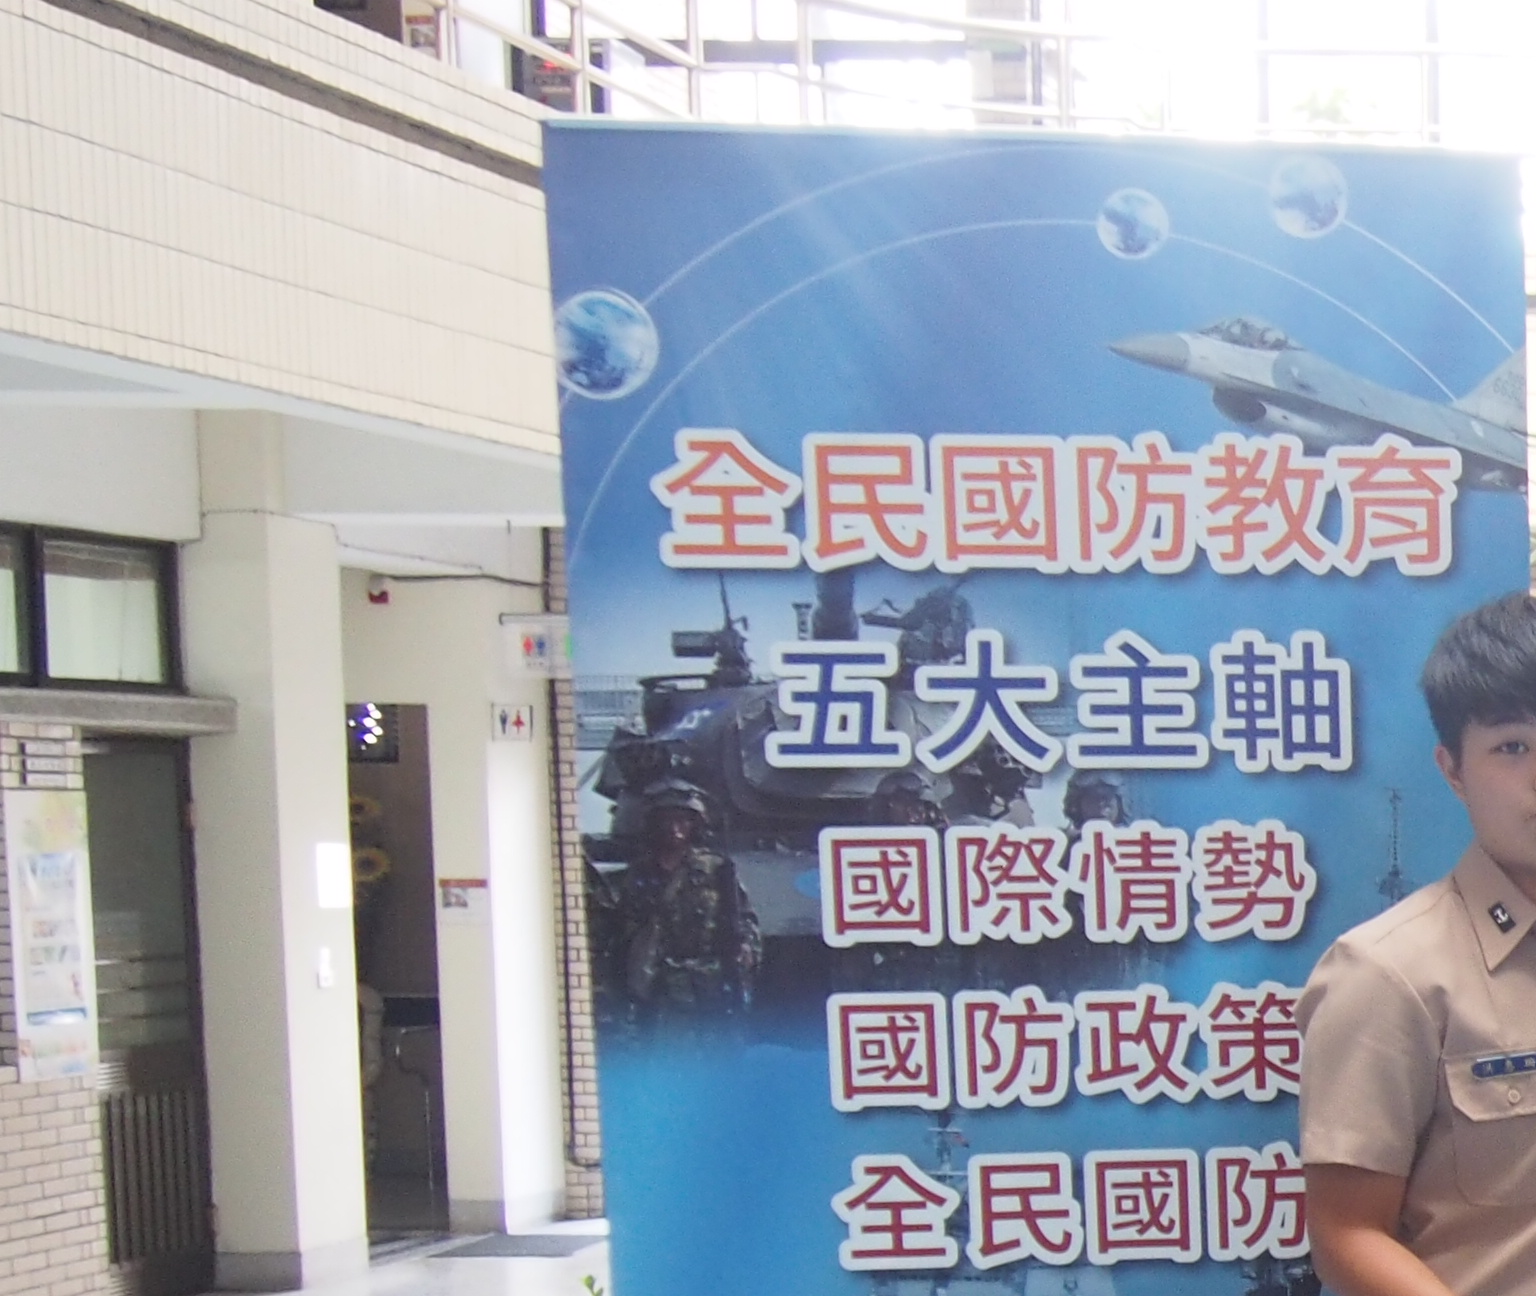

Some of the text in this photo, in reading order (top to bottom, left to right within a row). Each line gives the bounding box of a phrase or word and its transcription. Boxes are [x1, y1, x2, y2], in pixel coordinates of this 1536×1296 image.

[655, 433, 1458, 572] 全民國防教育
[775, 636, 1346, 767] 五大主軸
[826, 826, 1311, 940] 國際情勢
[834, 990, 1303, 1104] 國防政策
[842, 1157, 1306, 1262] 全民國防
